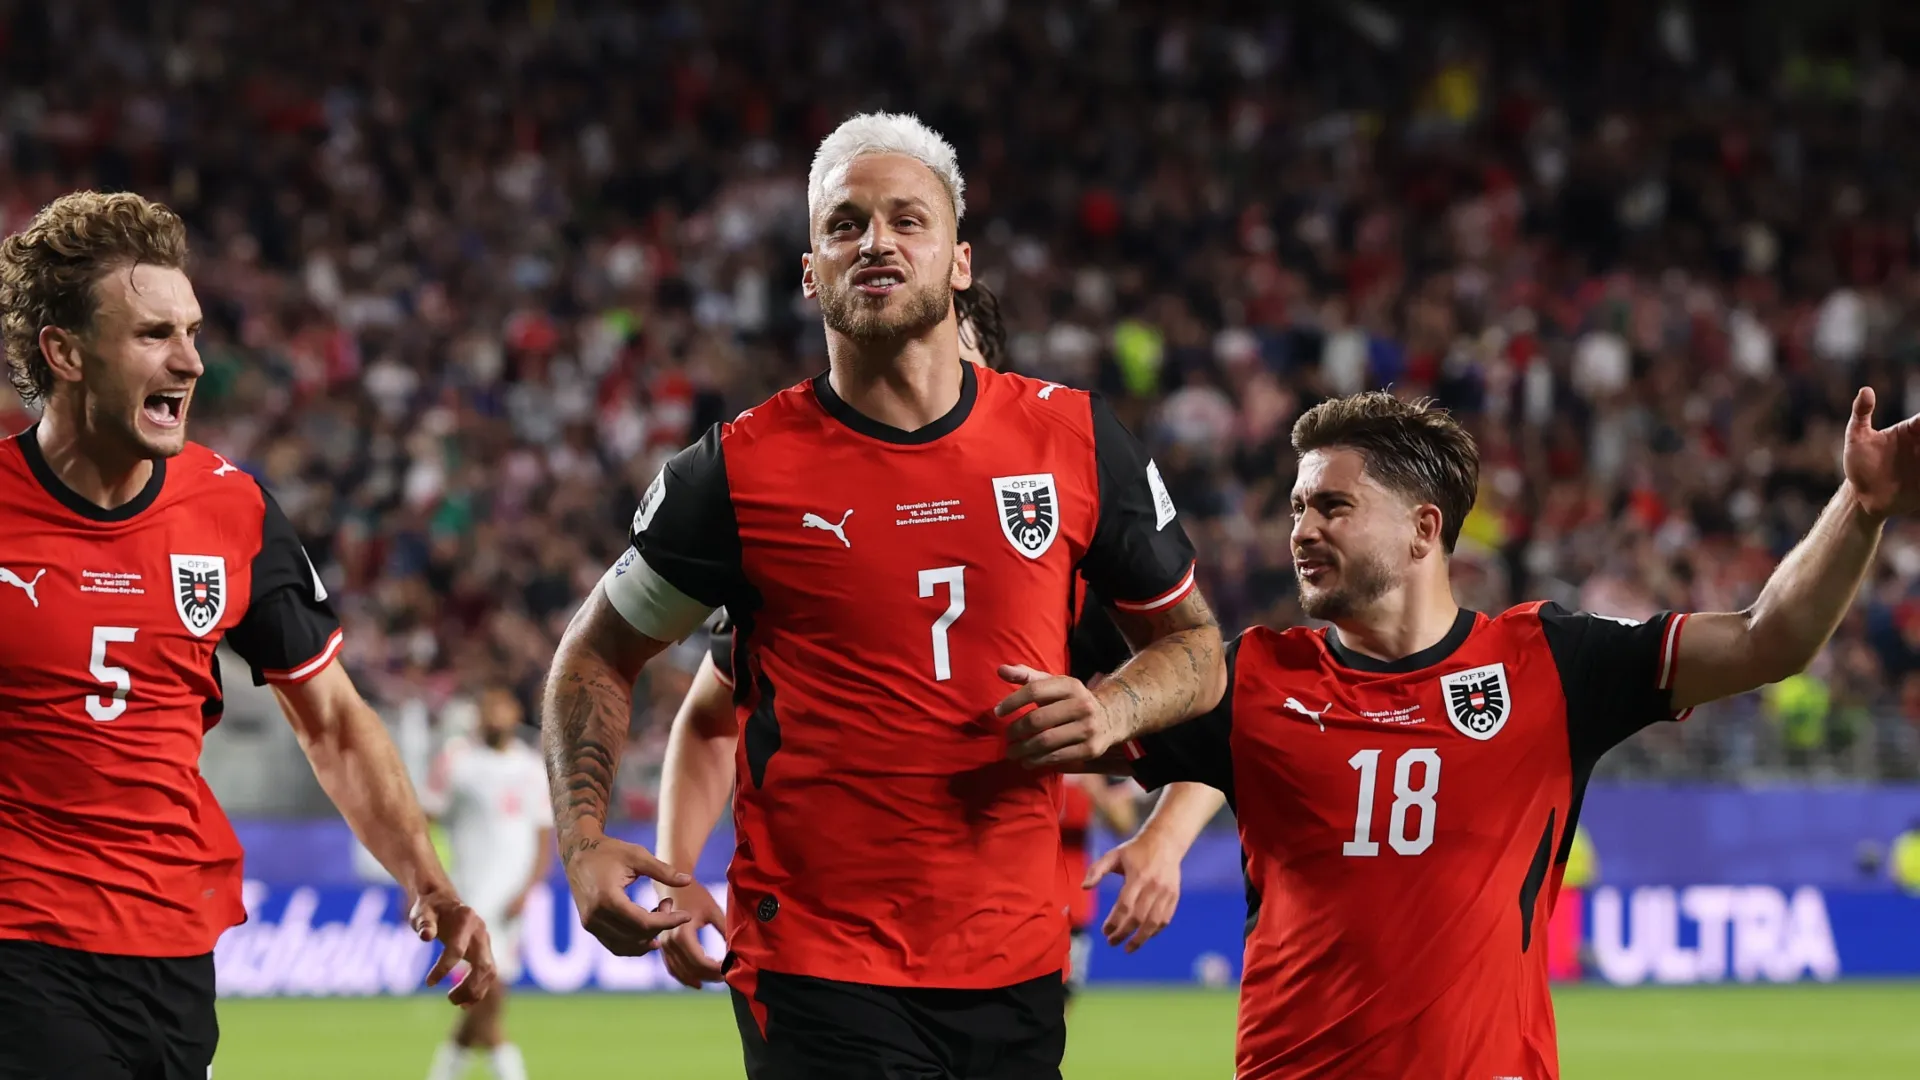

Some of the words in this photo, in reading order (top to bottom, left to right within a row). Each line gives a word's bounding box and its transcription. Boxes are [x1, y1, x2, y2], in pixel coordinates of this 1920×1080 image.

[896, 502, 927, 511] Österreich
[931, 499, 960, 508] Jordanien
[933, 507, 948, 515] 2026
[917, 565, 967, 682] 7
[85, 626, 140, 722] 5
[1342, 747, 1442, 857] 18
[1592, 884, 1841, 985] ULTRA
